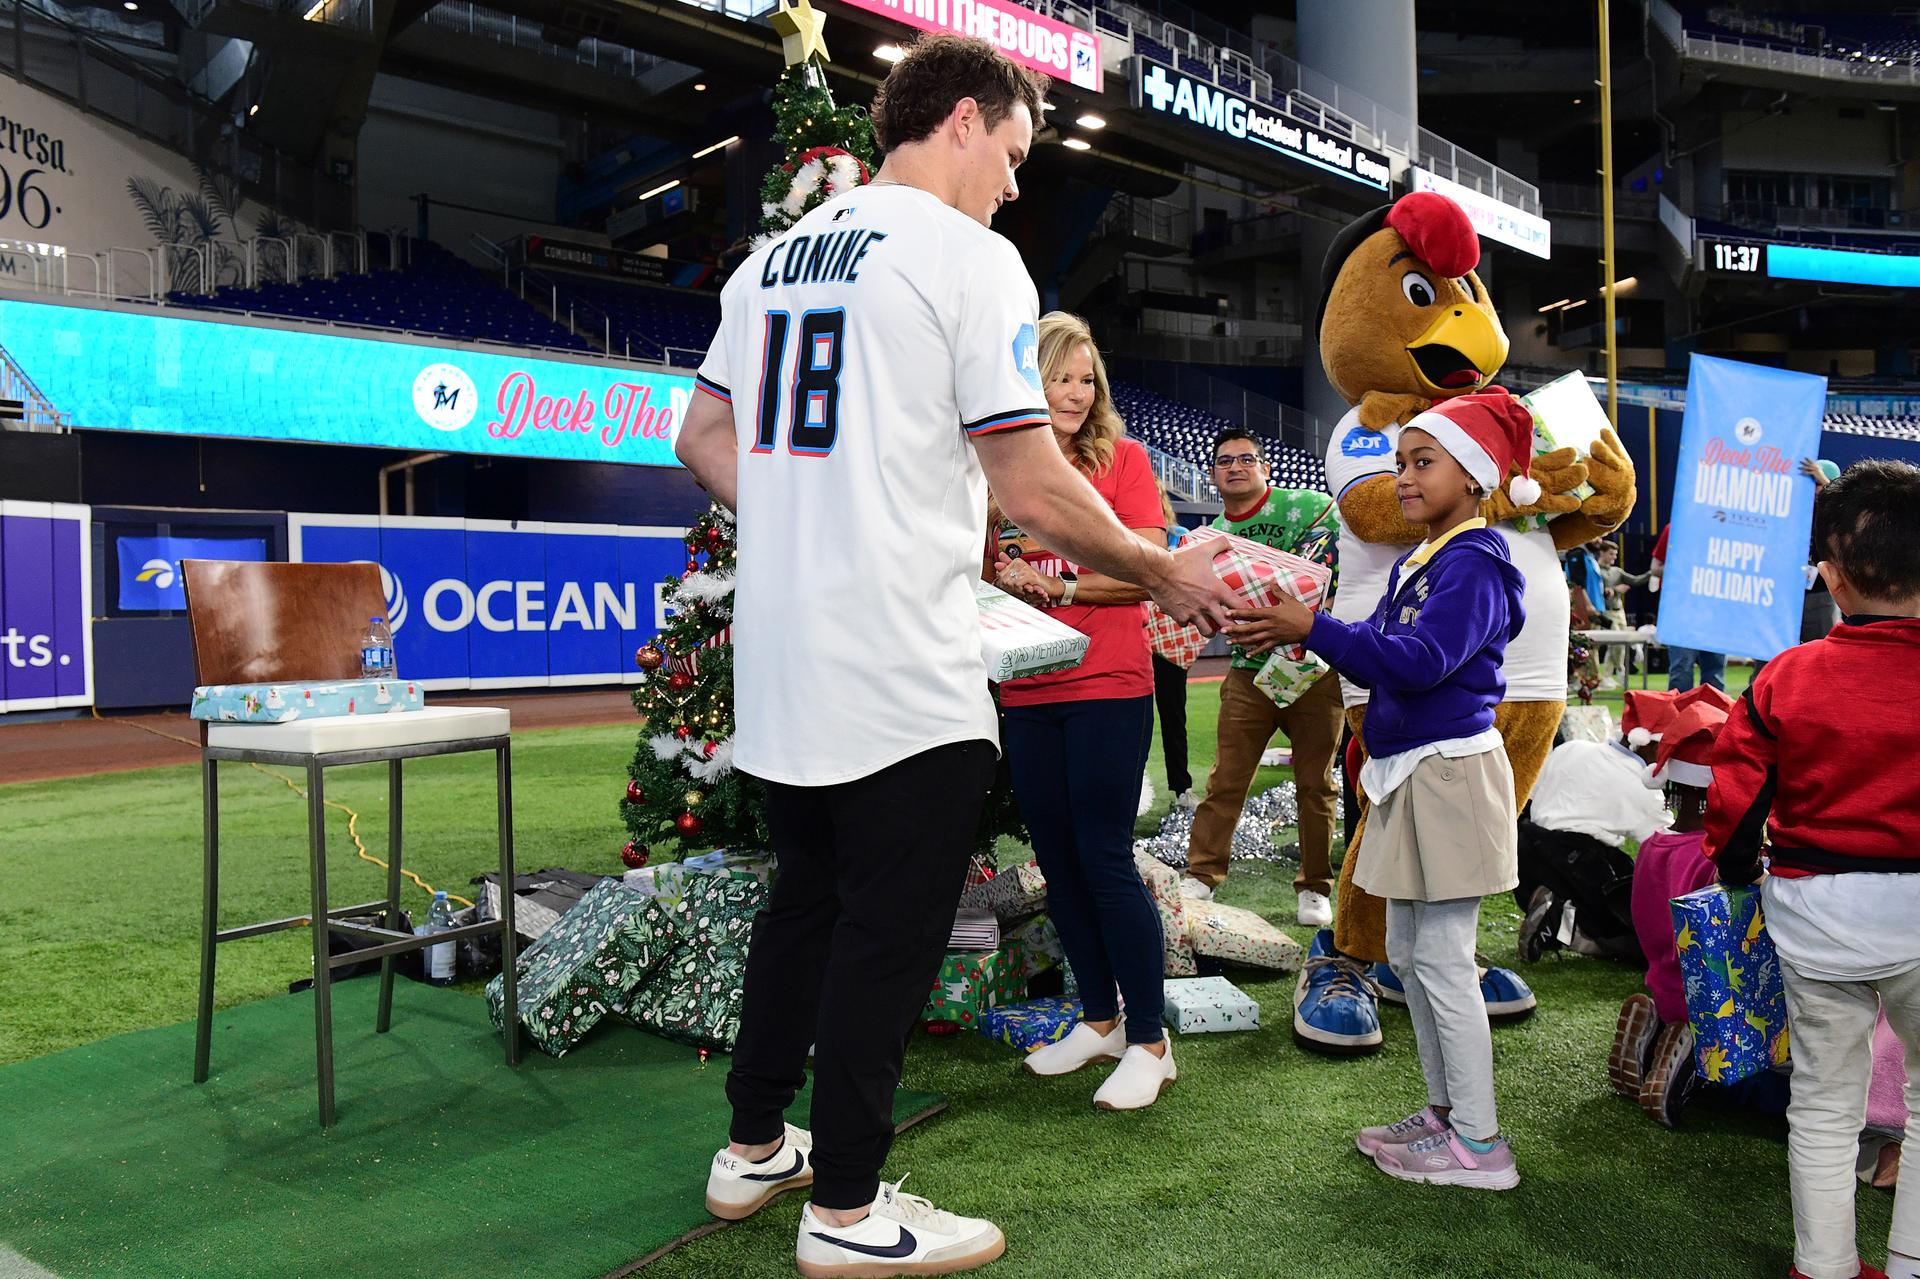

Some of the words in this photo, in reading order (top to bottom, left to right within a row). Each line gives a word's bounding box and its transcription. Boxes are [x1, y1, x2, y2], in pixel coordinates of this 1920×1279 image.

[1173, 77, 1247, 138] AMG
[1247, 109, 1303, 150] Accident
[1306, 131, 1352, 169] Medical
[1356, 151, 1390, 187] Group
[760, 228, 888, 290] CONINE
[1714, 244, 1760, 272] 11:37
[750, 305, 847, 458] 18
[487, 371, 595, 439] Deck
[600, 382, 673, 447] The
[1348, 436, 1383, 451] ADT
[1700, 435, 1752, 468] Deck
[1752, 444, 1793, 475] The
[1694, 459, 1793, 518] DIAMOND
[1233, 523, 1286, 539] SENTS
[1707, 536, 1765, 573] HAPPY
[423, 578, 636, 632] OCEAN
[1690, 565, 1775, 607] HOLIDAYS
[716, 1155, 738, 1172] NIKE
